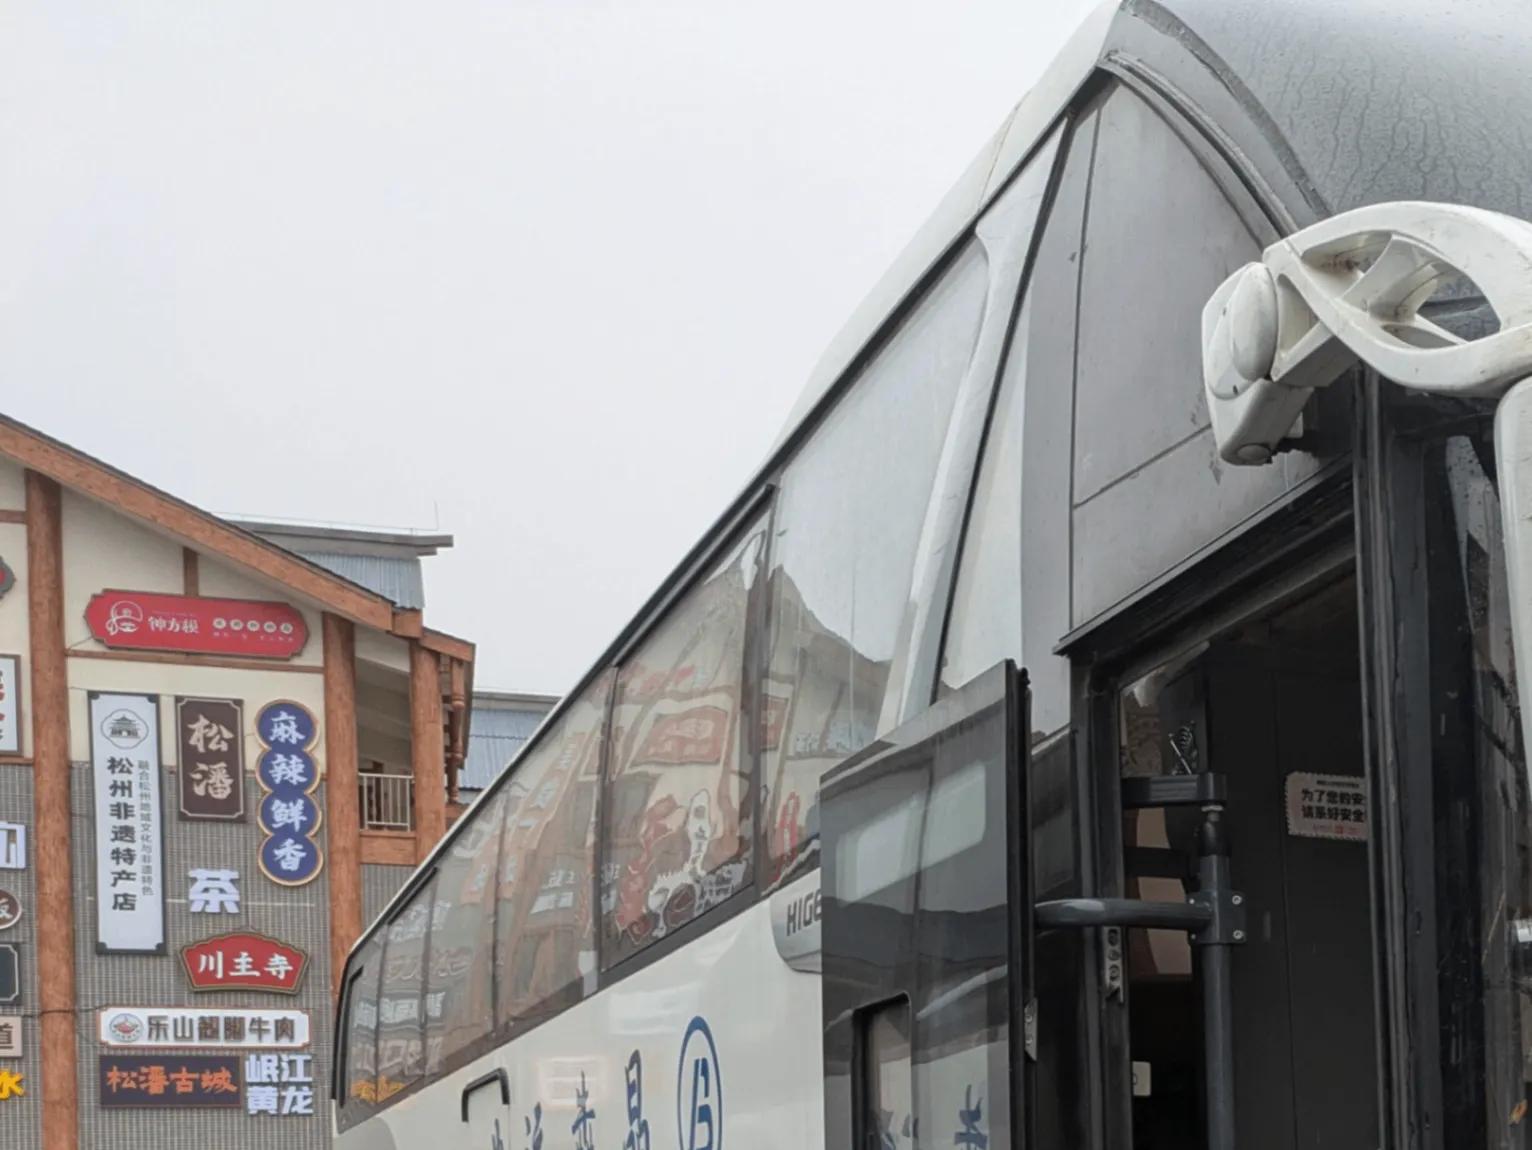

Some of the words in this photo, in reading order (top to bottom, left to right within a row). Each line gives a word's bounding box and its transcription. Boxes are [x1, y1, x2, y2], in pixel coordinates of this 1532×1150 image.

[188, 713, 235, 800] 松潘
[268, 710, 308, 873] 麻辣鲜香
[106, 755, 138, 912] 松州非遗特产店
[198, 950, 294, 981] 川主寺
[106, 1064, 238, 1096] 松潘古城
[245, 1052, 314, 1084] 岷江
[245, 1085, 314, 1115] 黄龙
